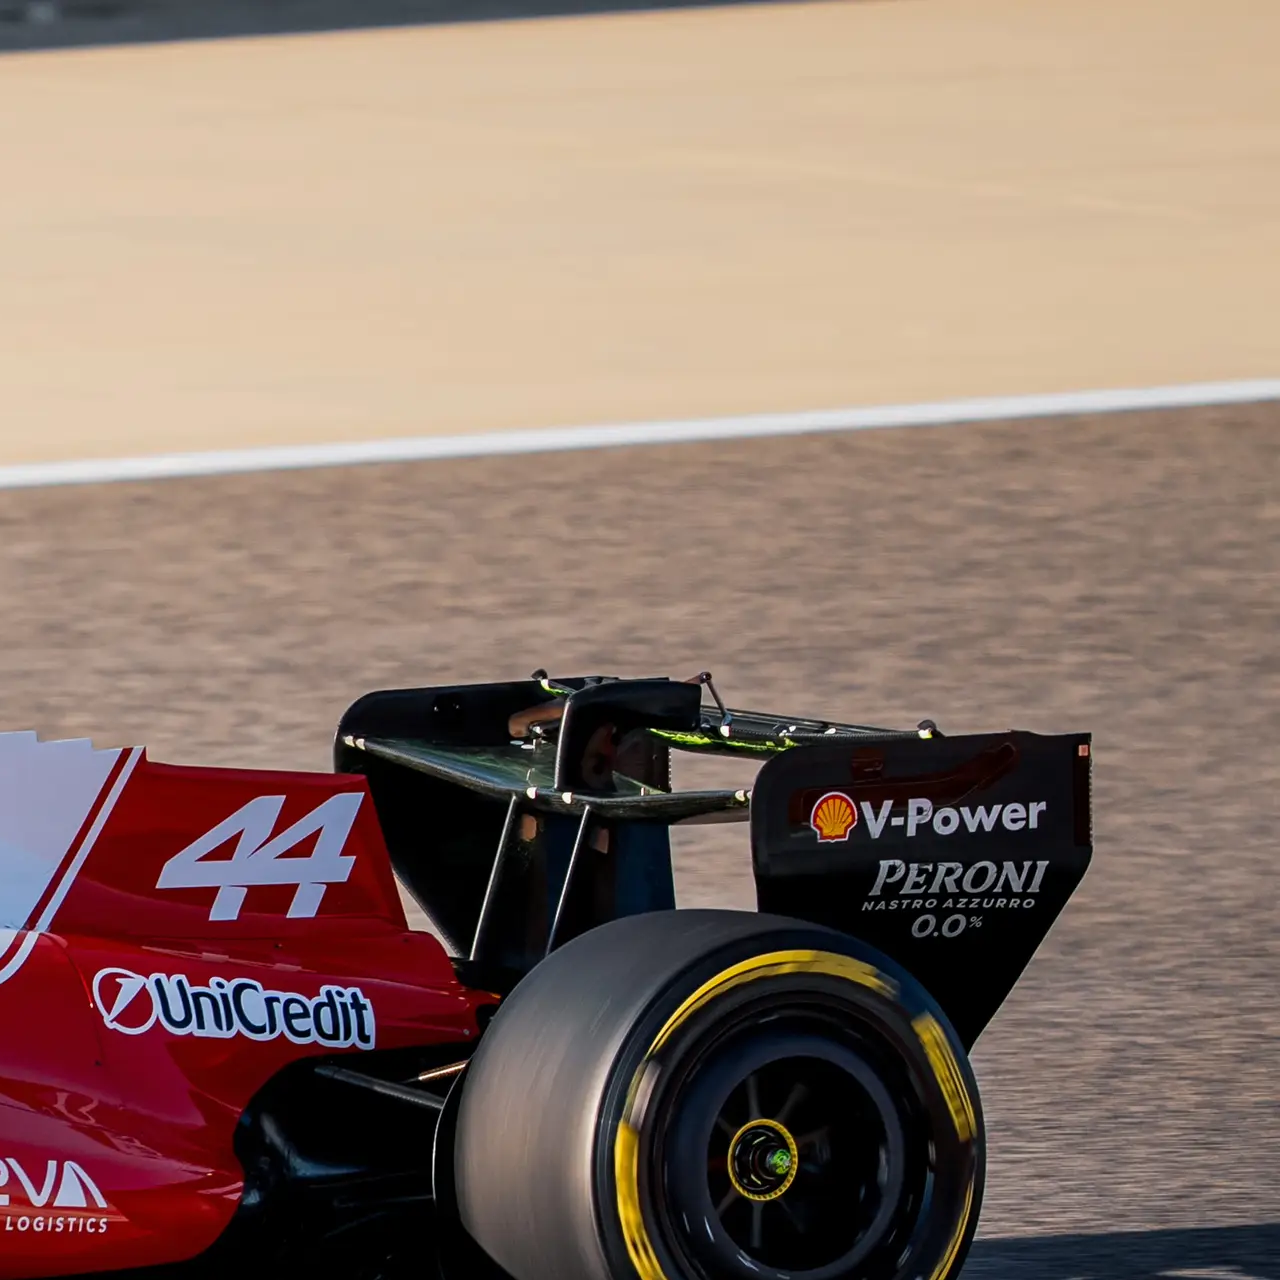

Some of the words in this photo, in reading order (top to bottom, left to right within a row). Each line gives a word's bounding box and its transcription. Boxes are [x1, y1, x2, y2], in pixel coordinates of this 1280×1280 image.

[860, 798, 1046, 839] V-Power
[156, 792, 366, 921] 44
[868, 859, 1049, 896] PERONI
[861, 899, 937, 911] NASTRO
[942, 898, 1036, 909] AZZURRO
[911, 913, 983, 938] 0.0%
[154, 976, 372, 1044] UniCredit
[5, 1216, 108, 1233] LOGISTICS
